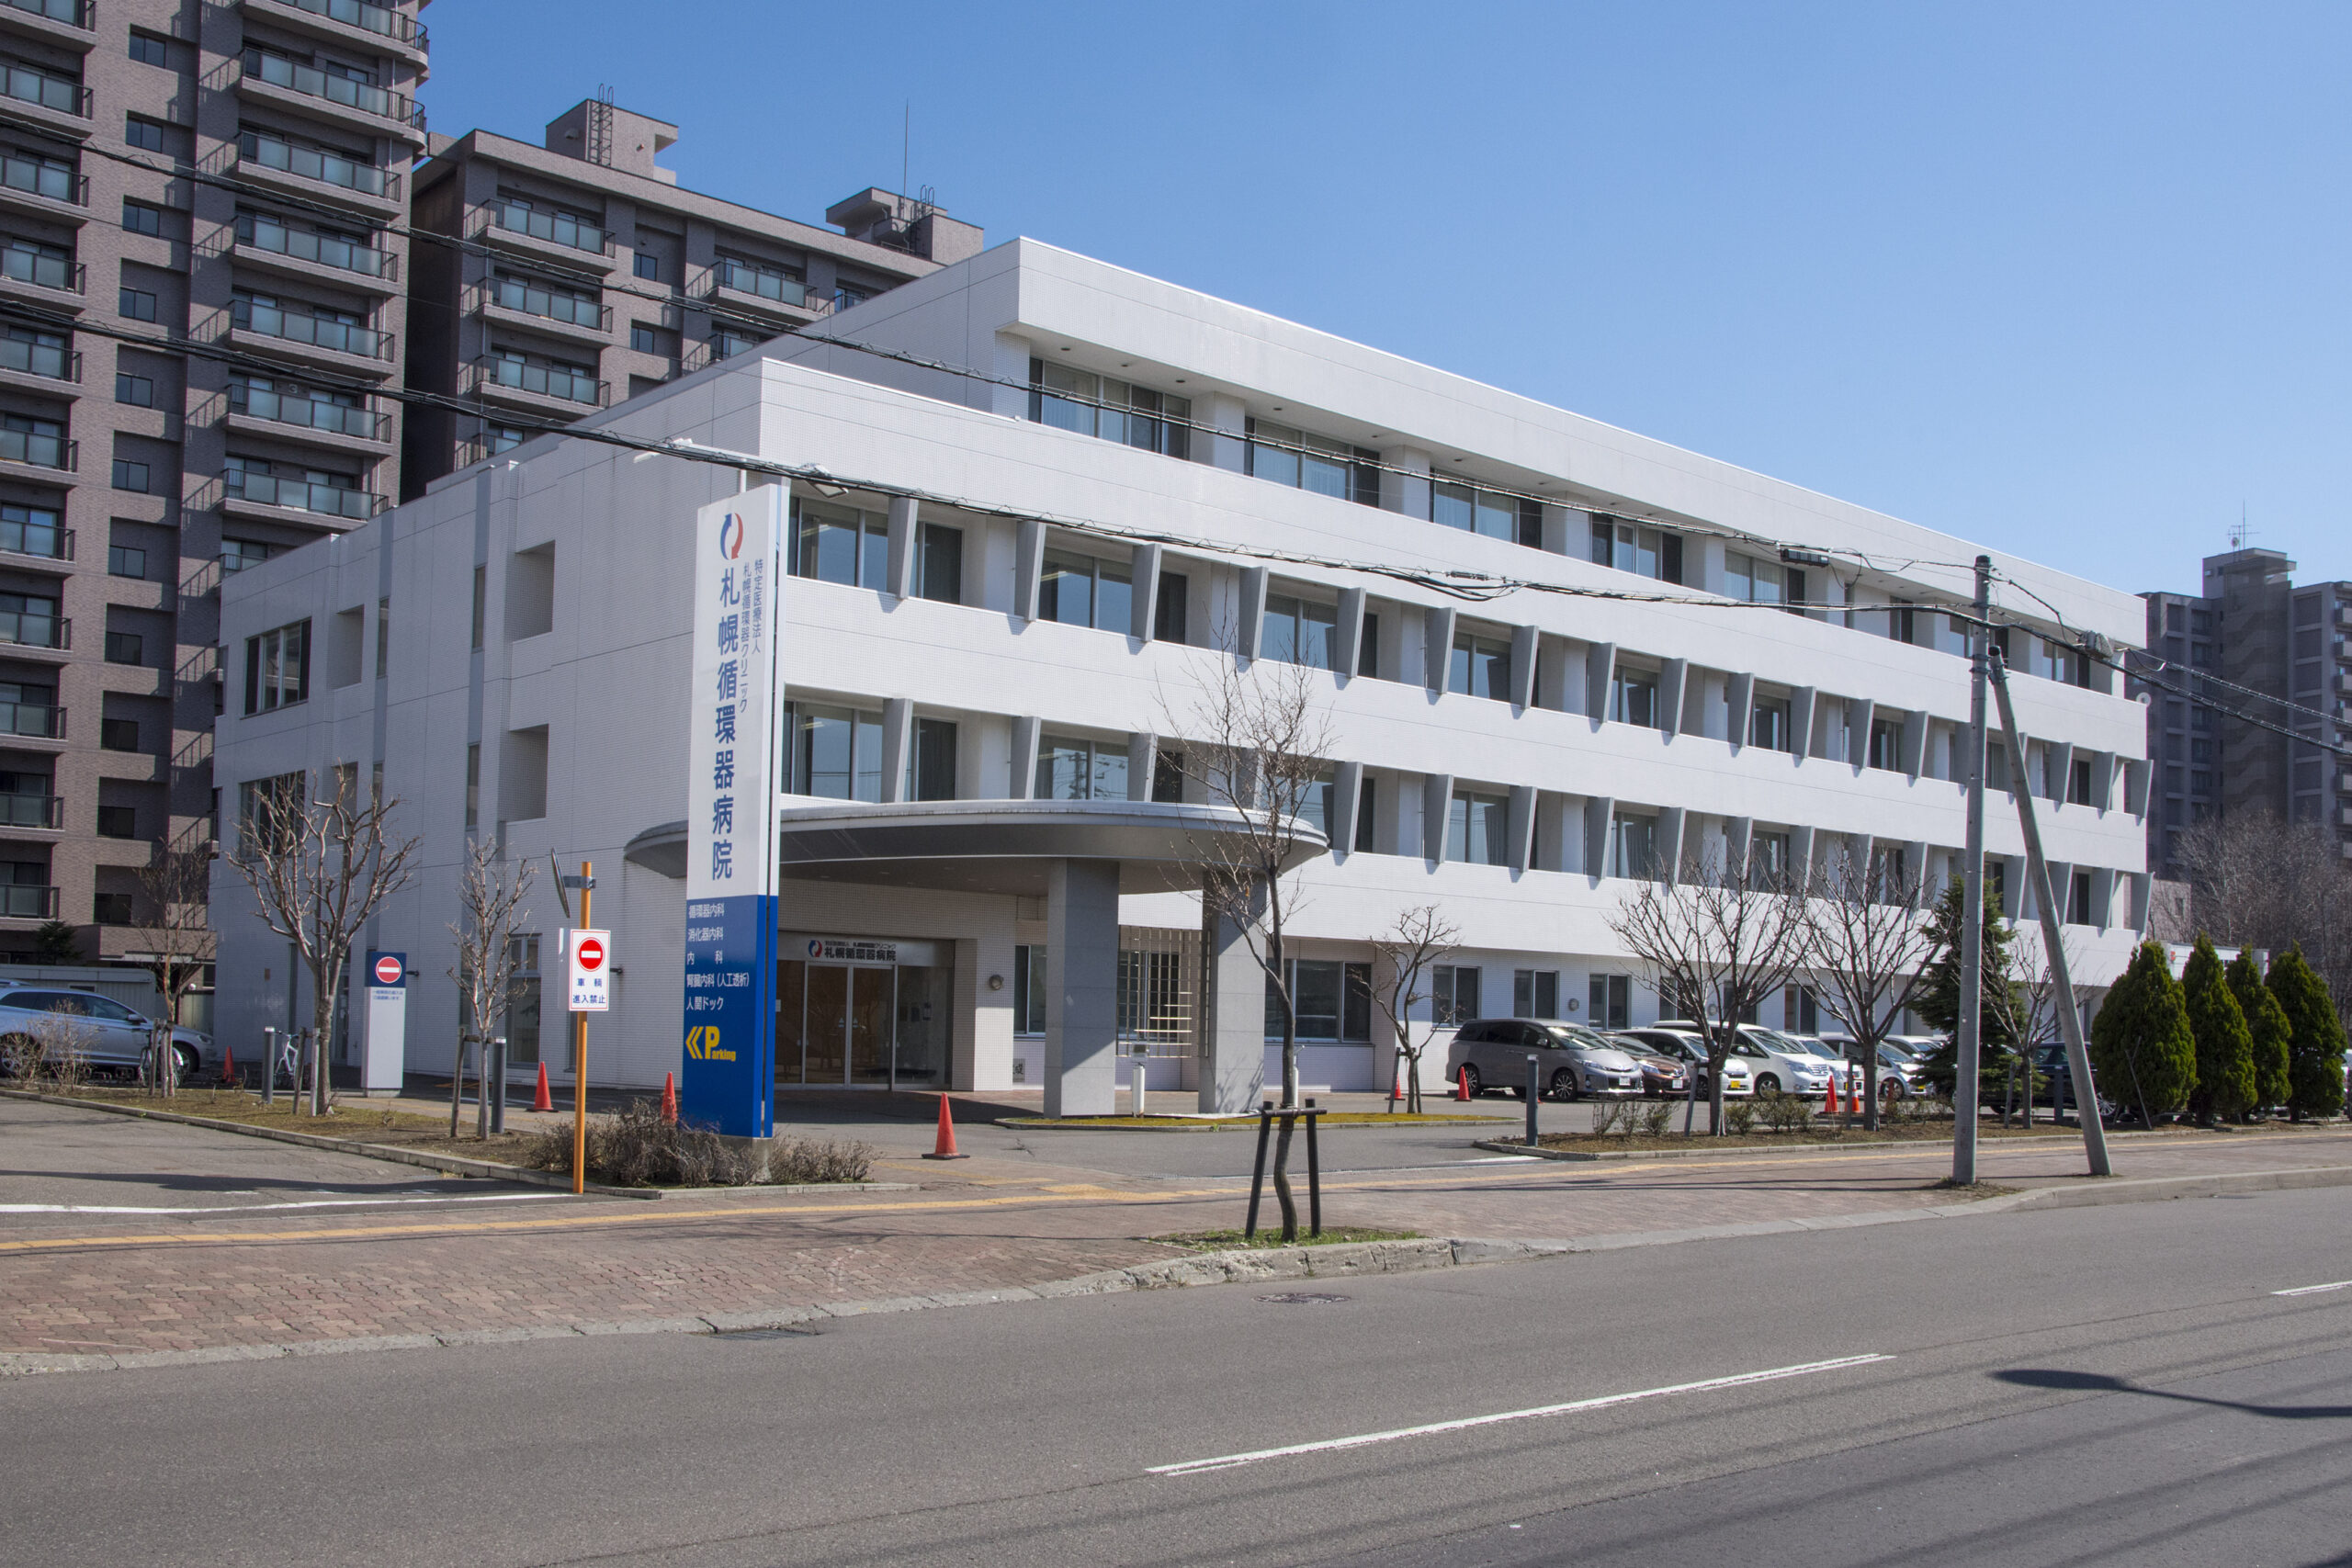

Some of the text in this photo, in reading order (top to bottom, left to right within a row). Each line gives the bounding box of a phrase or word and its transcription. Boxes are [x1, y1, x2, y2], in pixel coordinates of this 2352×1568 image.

[712, 567, 741, 881] 札幌循環器病院
[688, 903, 725, 919] 循環器内科
[687, 926, 724, 942] 消化器内科
[572, 994, 606, 1004] 進入禁止
[685, 996, 724, 1011] 人間ドック
[705, 1025, 737, 1062] Parking
